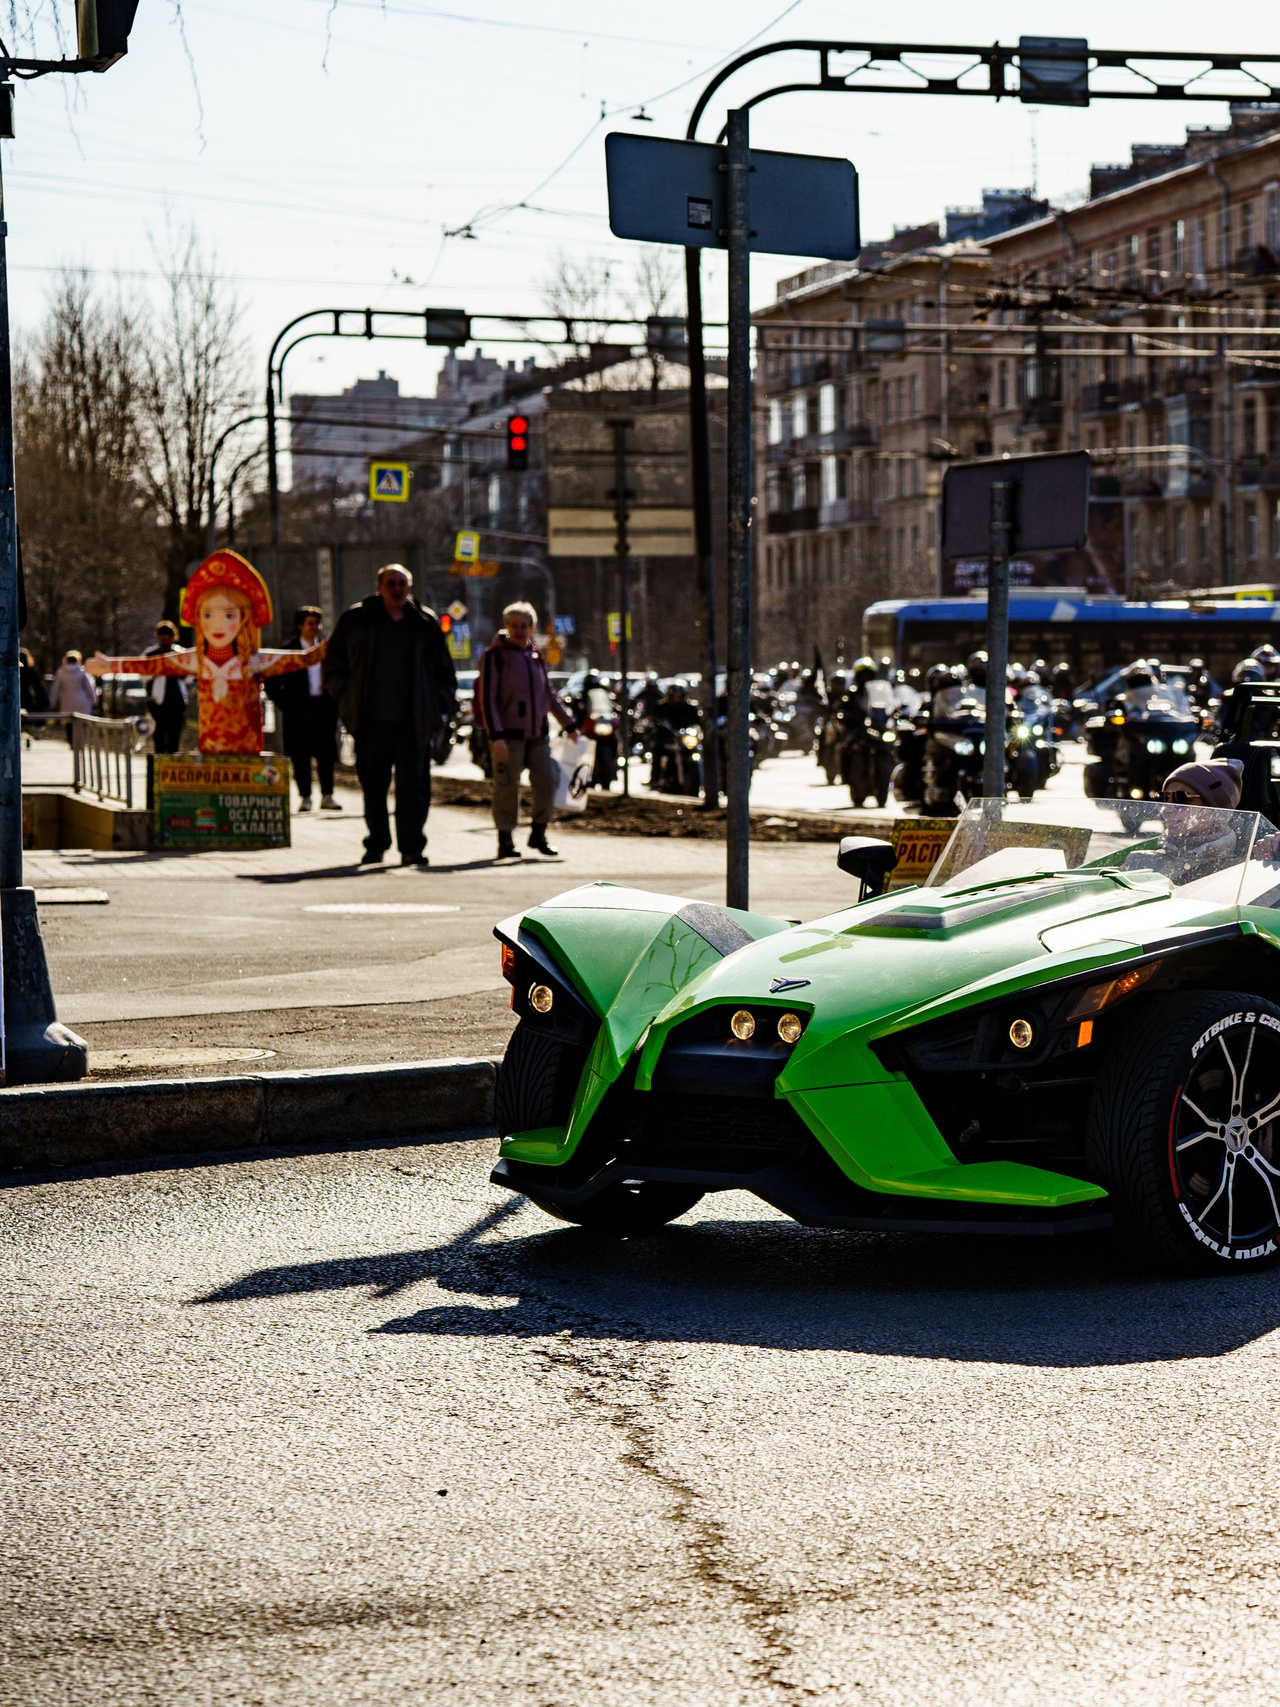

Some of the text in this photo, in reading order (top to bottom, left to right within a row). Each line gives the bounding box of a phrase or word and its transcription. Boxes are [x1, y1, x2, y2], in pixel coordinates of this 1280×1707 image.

[161, 770, 250, 785] РАСПРОДАЖА
[218, 794, 282, 808] ТОВАРНЫЕ
[229, 808, 283, 821] ОСТАТКИ
[233, 821, 283, 835] СКЛАДА
[1191, 1012, 1244, 1059] PITBIKE
[1244, 1011, 1257, 1023] &
